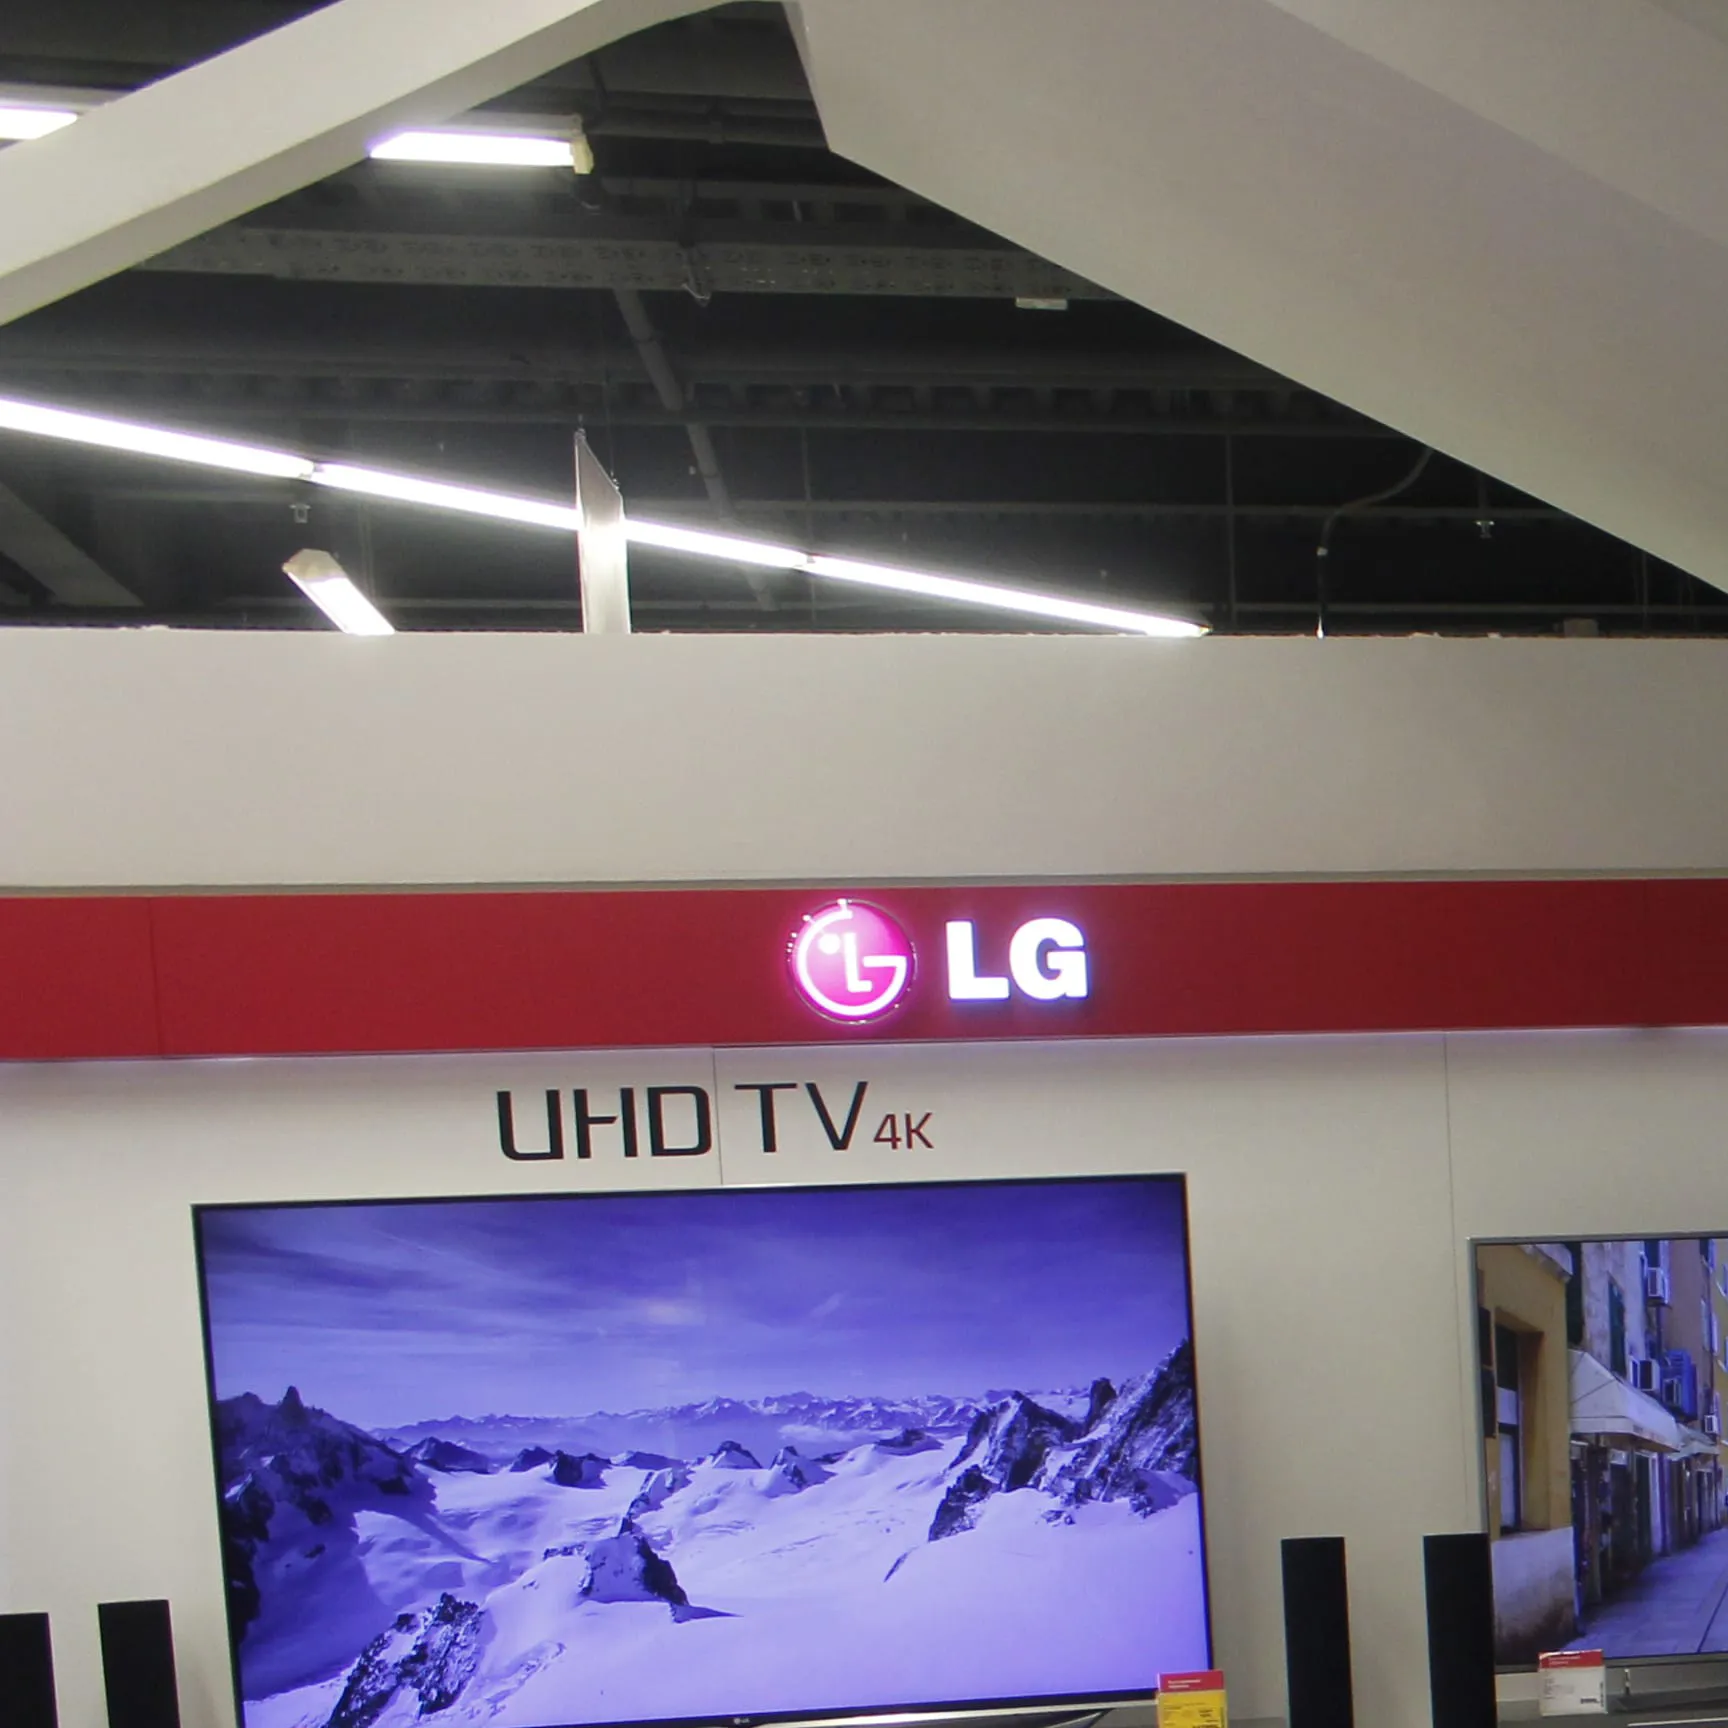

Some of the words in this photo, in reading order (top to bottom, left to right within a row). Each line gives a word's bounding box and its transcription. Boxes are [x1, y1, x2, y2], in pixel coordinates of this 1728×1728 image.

[945, 917, 1090, 1001] LG
[496, 1084, 714, 1162] UHD
[734, 1080, 869, 1154] TV
